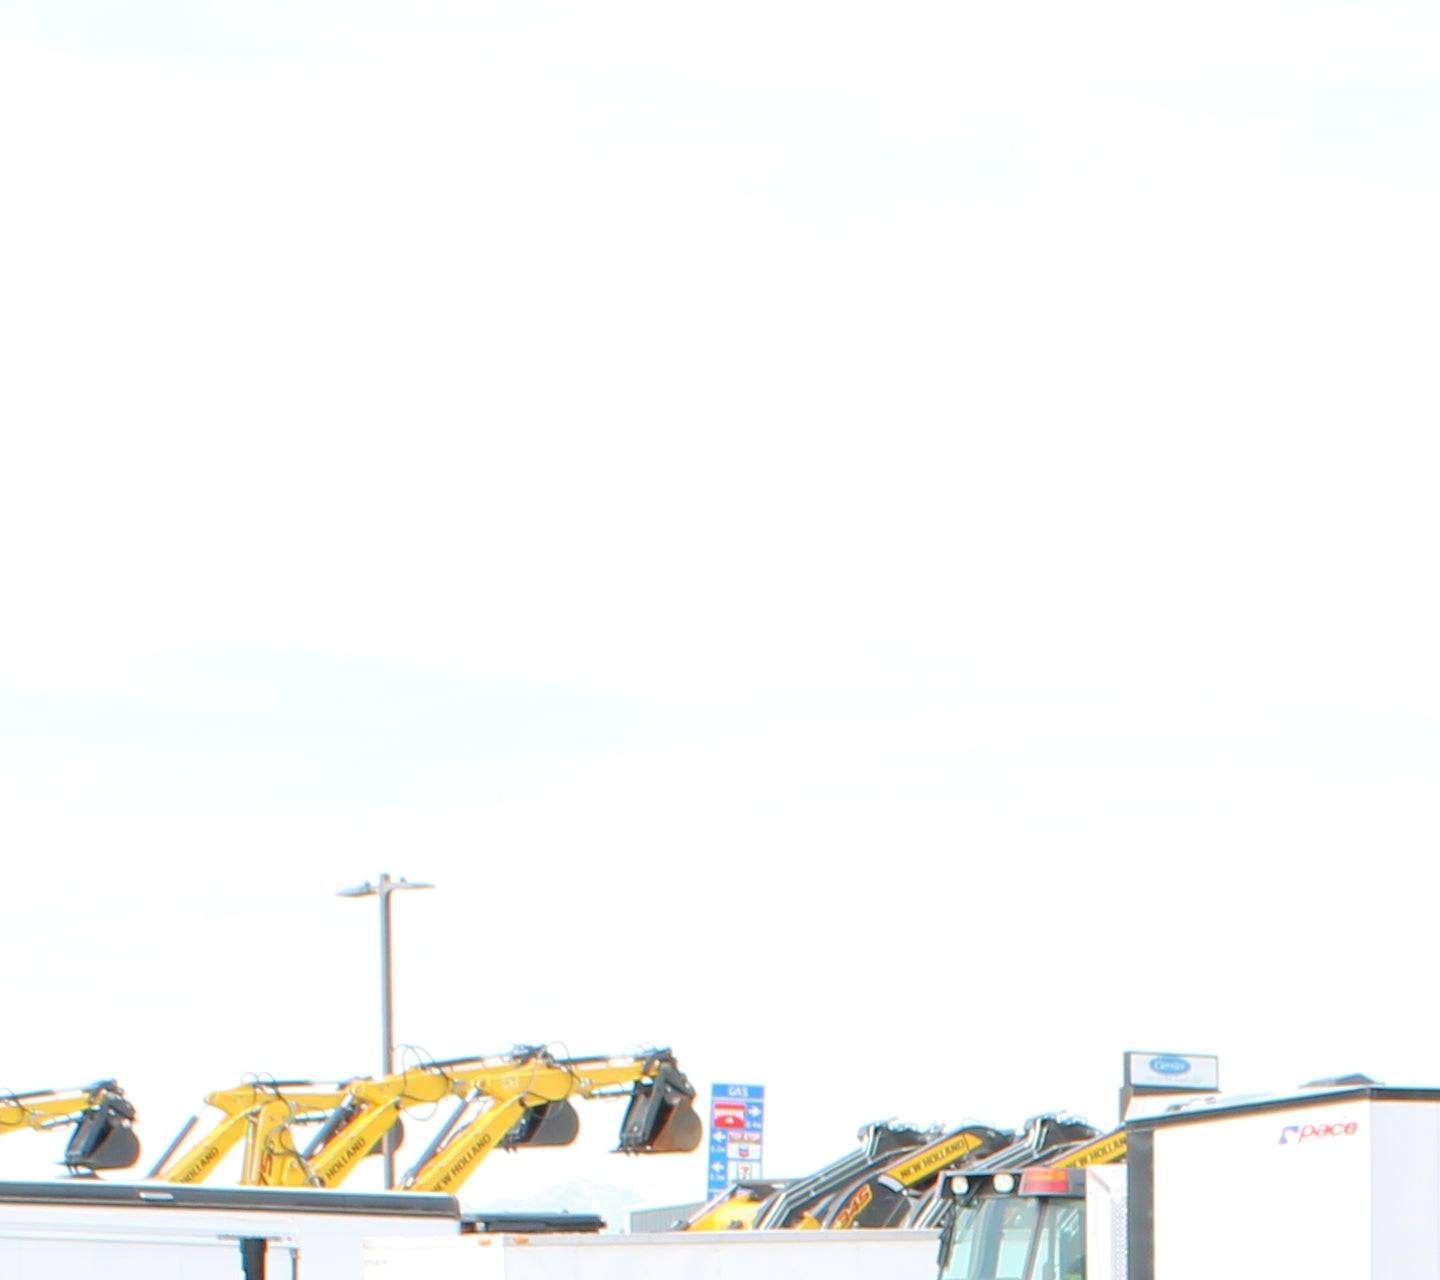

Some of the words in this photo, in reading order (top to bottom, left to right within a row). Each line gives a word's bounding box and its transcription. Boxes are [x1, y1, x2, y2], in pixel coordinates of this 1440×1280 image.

[728, 1087, 749, 1098] GAS
[326, 1136, 367, 1180] HOLLAND
[450, 1133, 492, 1177] HOLLAND
[1088, 1137, 1127, 1163] HOLLAN
